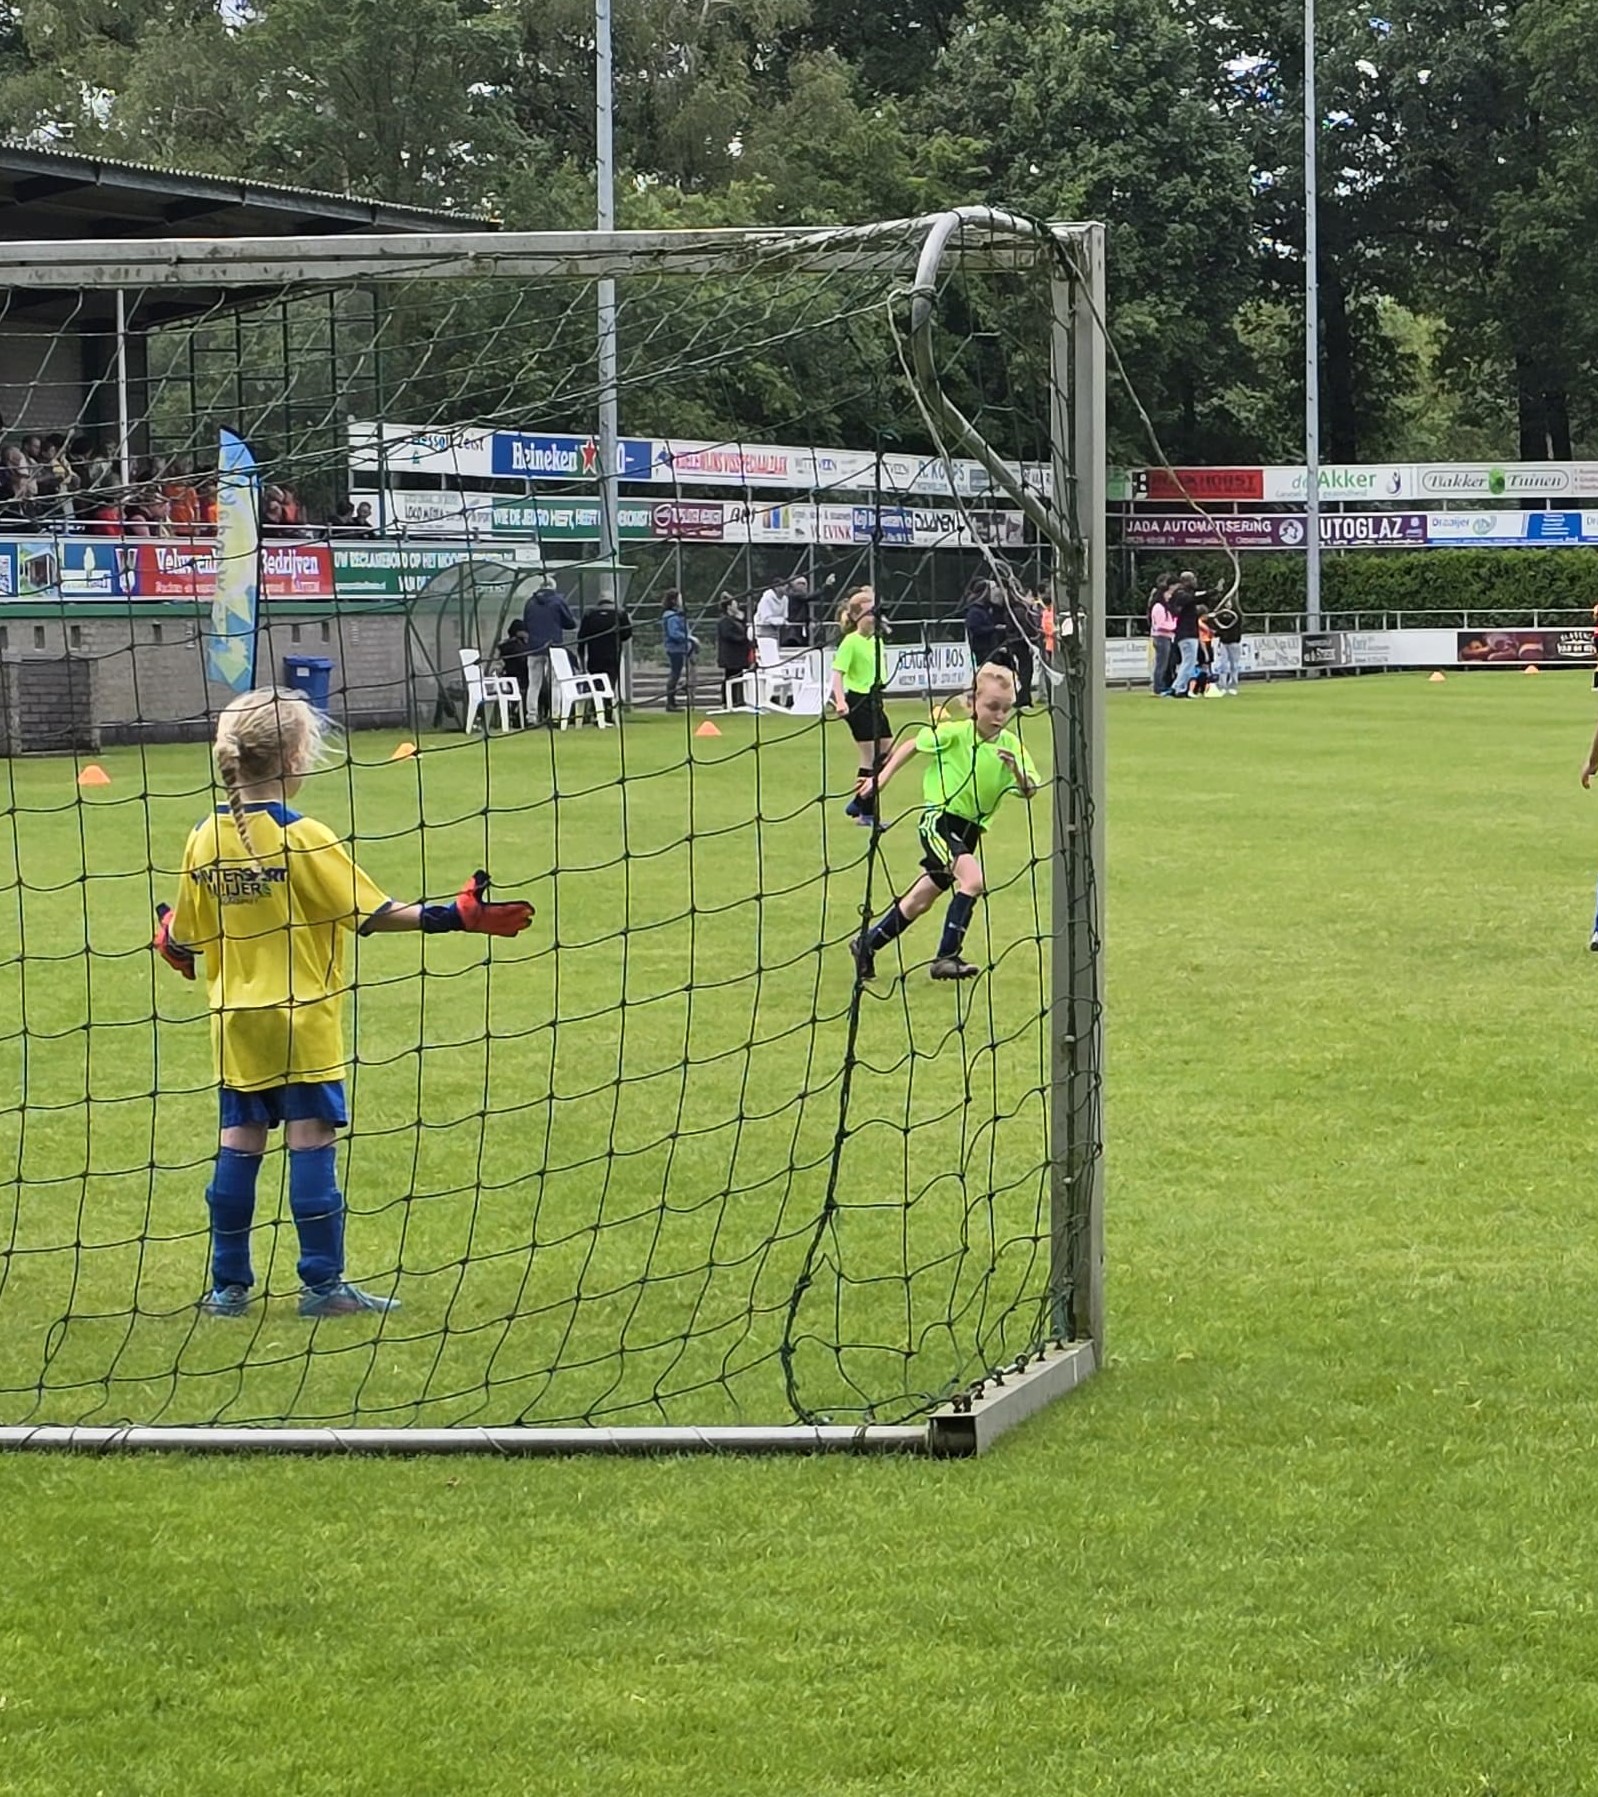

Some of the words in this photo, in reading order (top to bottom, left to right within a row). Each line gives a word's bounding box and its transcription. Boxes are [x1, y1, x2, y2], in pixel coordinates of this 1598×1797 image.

[512, 441, 577, 472] Heineken
[1318, 469, 1377, 488] Akker
[1428, 474, 1486, 489] Bakker
[1509, 473, 1562, 487] Tuinen
[1127, 520, 1160, 533] JADA
[1163, 519, 1272, 533] AUTOMATISERING
[1319, 517, 1403, 539] UTOGLAZ
[190, 866, 287, 885] INTERSORT
